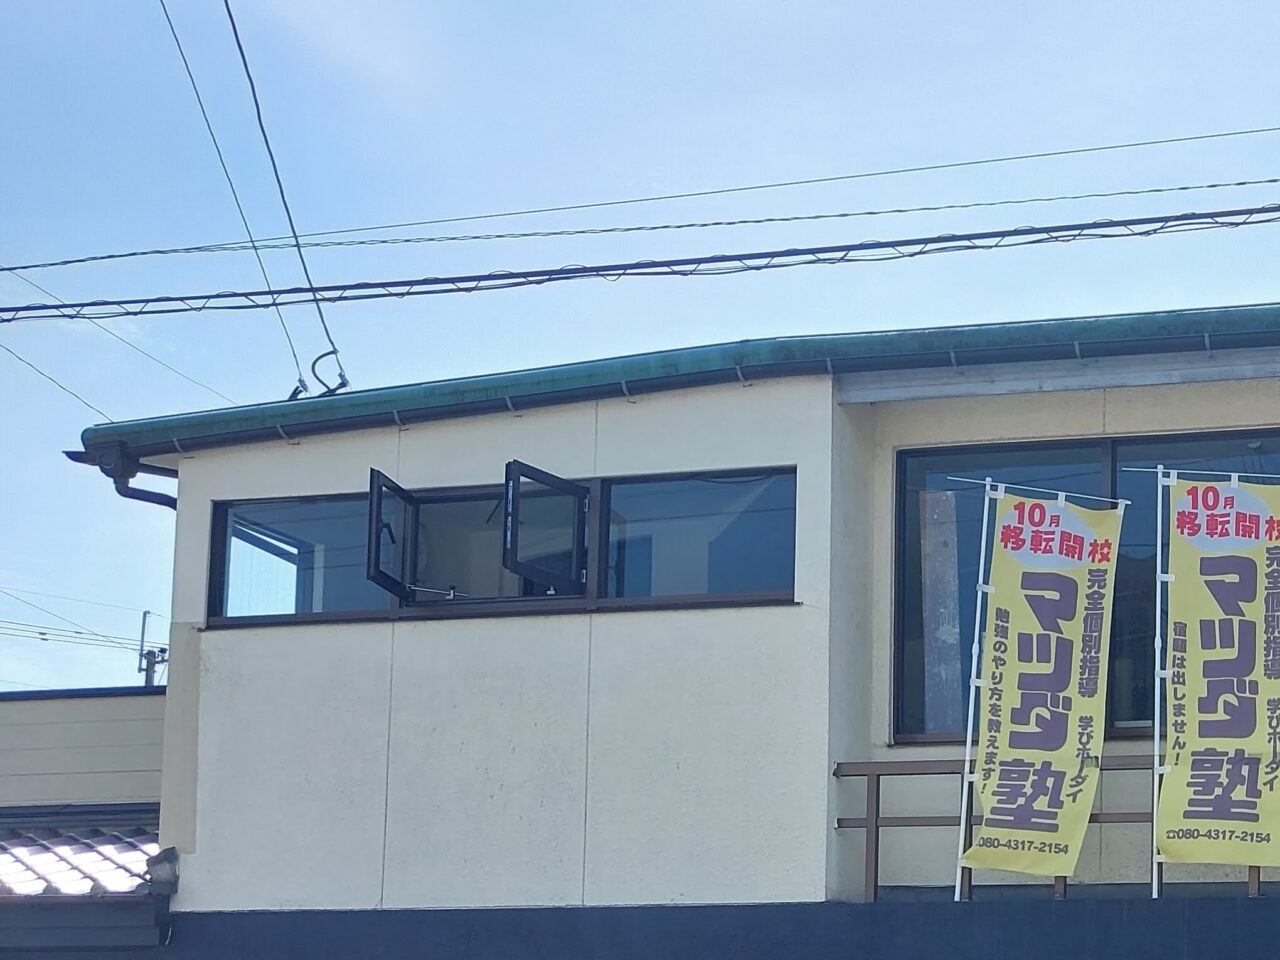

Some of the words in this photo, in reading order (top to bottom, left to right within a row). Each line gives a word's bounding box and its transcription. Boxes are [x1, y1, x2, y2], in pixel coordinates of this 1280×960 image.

[1013, 502, 1060, 528] 10月
[1186, 486, 1235, 511] 10月
[1000, 524, 1112, 563] 移転開校
[1078, 568, 1108, 698] 完全個別指導
[984, 571, 1079, 832] マツダ塾
[1182, 555, 1262, 822] マツダ塾
[1177, 829, 1271, 843] 080-4317-2154
